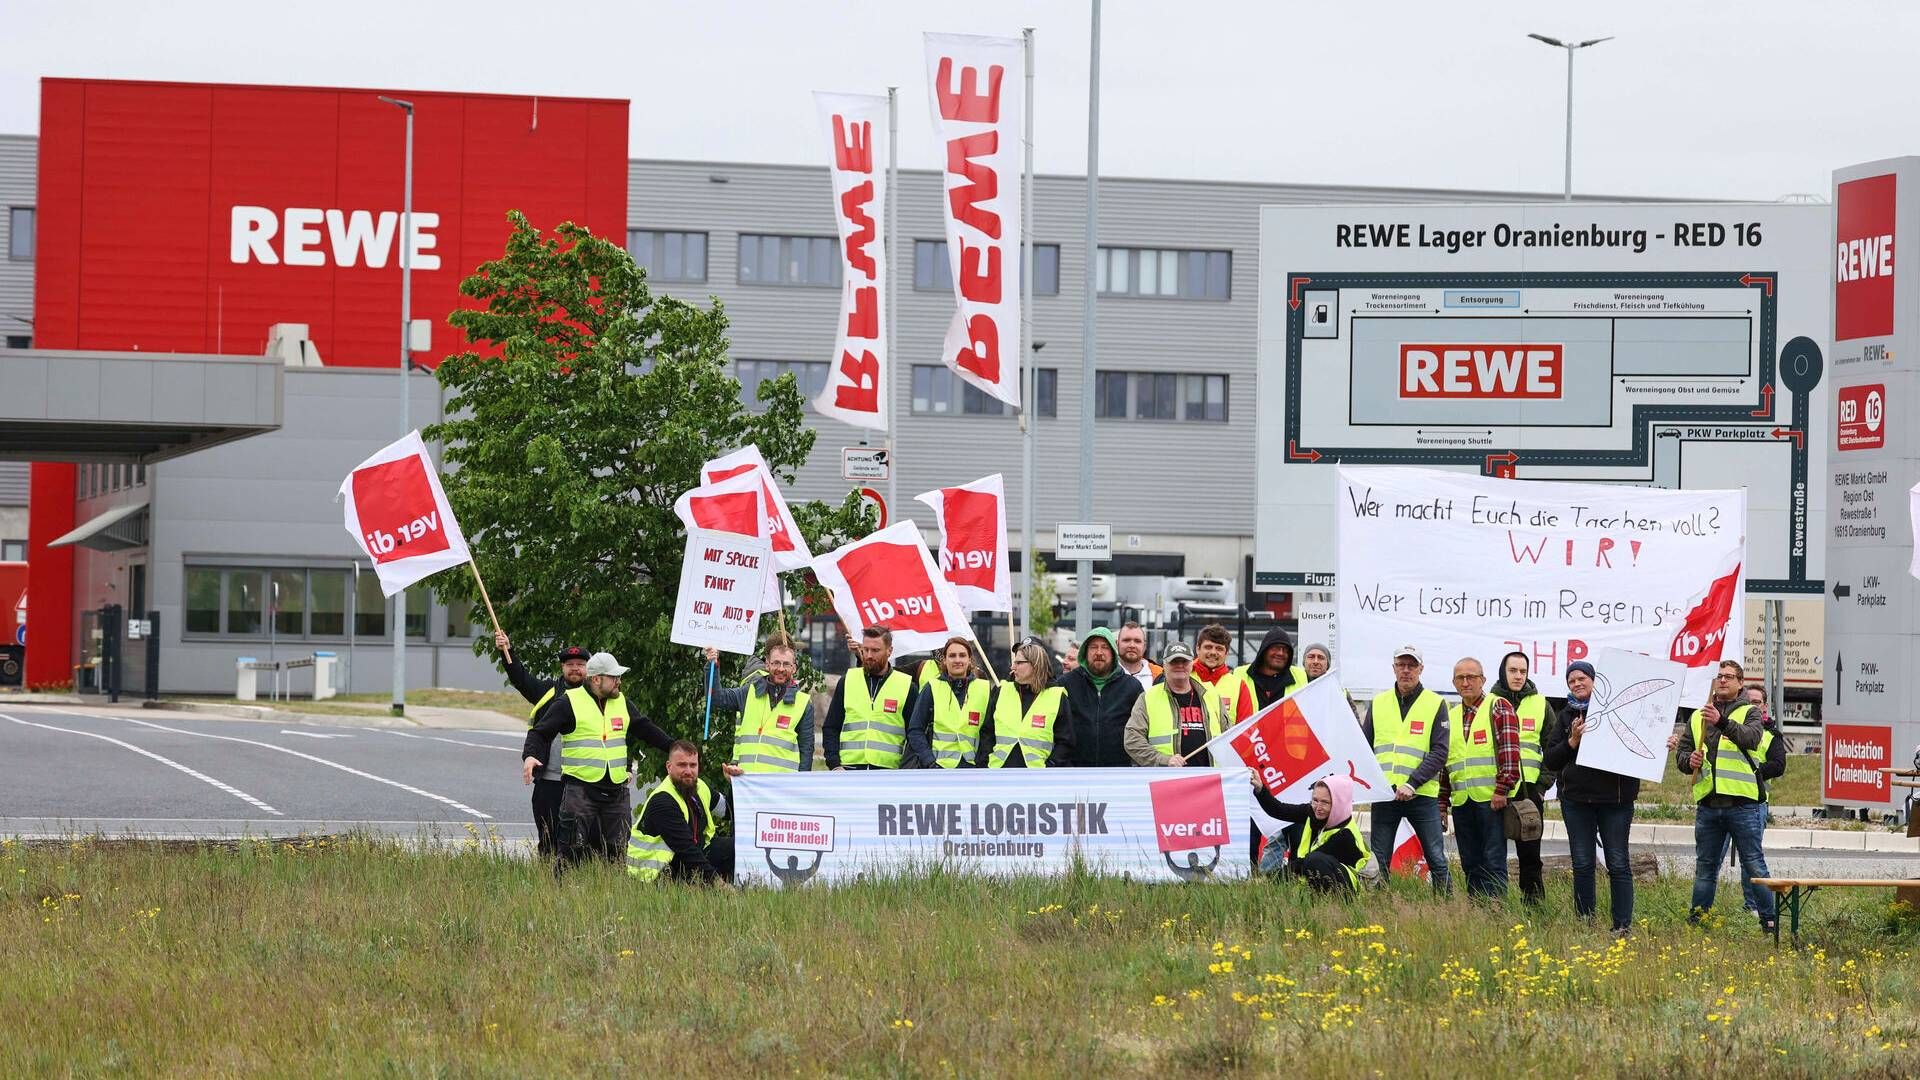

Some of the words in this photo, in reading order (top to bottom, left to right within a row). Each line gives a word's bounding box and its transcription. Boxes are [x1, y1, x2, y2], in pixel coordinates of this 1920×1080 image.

[230, 205, 440, 270] REWE
[1336, 223, 1410, 248] REWE
[1419, 223, 1486, 254] Lager
[1494, 223, 1647, 253] Oranienburg
[1674, 223, 1726, 247] RED
[1733, 223, 1762, 247] 16
[1837, 234, 1893, 283] REWE
[1371, 293, 1420, 302] Wareneingang
[1460, 296, 1504, 305] Entsorgung
[1614, 293, 1664, 302] Wareneingang
[1663, 302, 1705, 310] Tiefkühlung
[1864, 344, 1886, 361] REWE
[1406, 350, 1556, 393] REWE
[1625, 386, 1676, 395] Wareneingang
[1678, 386, 1694, 394] Obst
[1696, 386, 1709, 394] und
[1712, 386, 1740, 394] Gemüse
[1840, 399, 1857, 422] RED
[1868, 398, 1880, 420] 16
[1416, 437, 1466, 445] Wareneingang
[1468, 437, 1493, 445] Shuttle
[1687, 428, 1712, 438] PKW
[1715, 428, 1766, 439] Parkplatz
[1835, 473, 1850, 486] REWE
[1851, 473, 1866, 485] Markt
[1867, 471, 1888, 484] GmbH
[1843, 490, 1861, 505] Region
[1863, 489, 1874, 502] Ost
[1349, 486, 1384, 518] Wer
[1395, 498, 1453, 520] macht
[1472, 495, 1521, 525] Euch
[1530, 509, 1558, 527] die
[1840, 508, 1872, 520] Rewestraße
[1873, 507, 1877, 518] 1
[1792, 482, 1805, 556] Rewestraße
[1834, 525, 1848, 538] 16515
[1849, 525, 1886, 539] Oranienburg
[703, 547, 723, 562] MIT
[1304, 573, 1335, 586] Flugp
[1863, 576, 1881, 588] LKW-
[693, 600, 713, 616] KEIN
[1353, 583, 1405, 612] Wer
[1476, 596, 1512, 618] uns
[1523, 593, 1546, 619] im
[1559, 589, 1643, 624] Regen
[1857, 594, 1886, 608] Parkplatz
[1302, 611, 1327, 620] Unser
[1861, 662, 1879, 675] PKW-
[1855, 680, 1885, 695] Parkplatz
[1834, 740, 1884, 760] Abholstation
[1249, 727, 1287, 790] ver.di
[1834, 763, 1883, 788] Oranienburg
[770, 817, 797, 831] Ohne
[800, 820, 820, 832] uns
[877, 803, 962, 836] REWE
[970, 802, 1109, 836] LOGISTIK
[1160, 818, 1222, 837] ver.di
[761, 830, 785, 843] kein
[786, 832, 829, 845] Handel!
[943, 839, 1044, 857] Oranienburg
